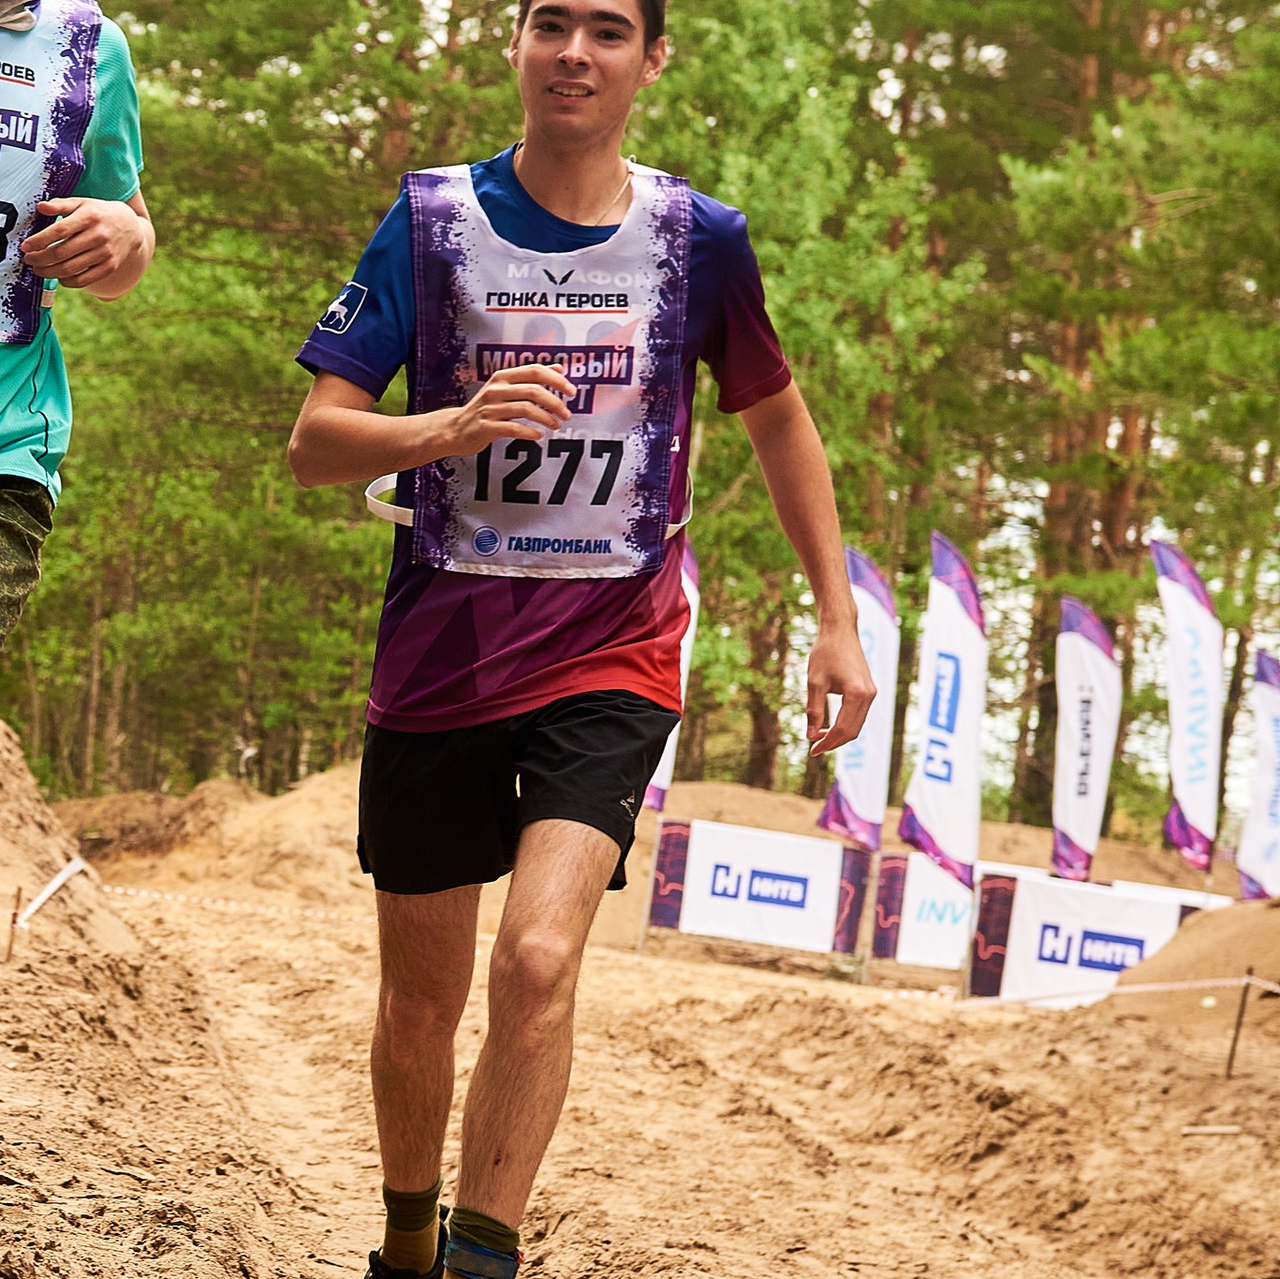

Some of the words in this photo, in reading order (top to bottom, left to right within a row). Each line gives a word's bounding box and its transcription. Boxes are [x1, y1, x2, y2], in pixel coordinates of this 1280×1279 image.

[485, 292, 549, 308] ГОНКА
[555, 293, 628, 308] ГЕРОЕВ
[474, 438, 624, 505] 1277
[507, 536, 612, 554] ГАЗПРОМБАНК
